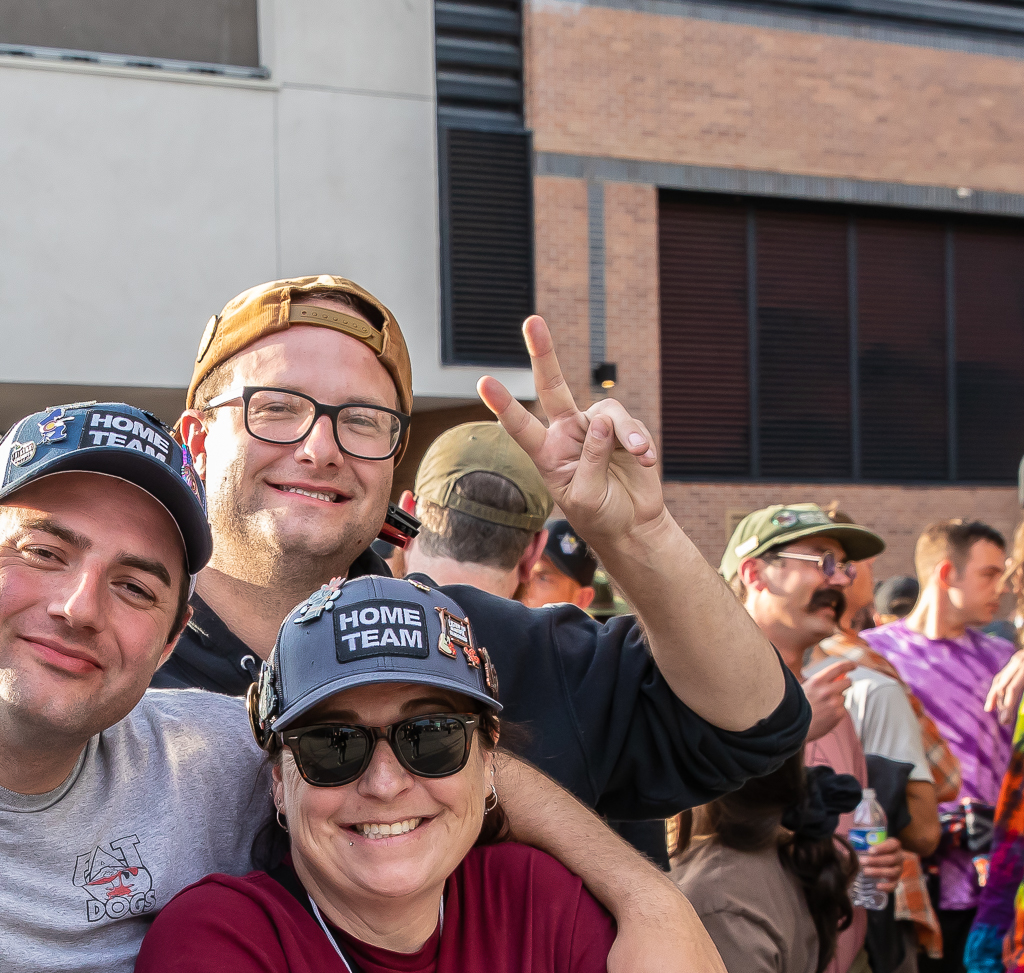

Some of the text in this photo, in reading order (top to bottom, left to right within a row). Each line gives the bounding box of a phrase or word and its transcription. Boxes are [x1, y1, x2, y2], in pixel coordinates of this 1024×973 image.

[88, 430, 167, 463] TEAM
[90, 413, 170, 455] HOME
[339, 606, 422, 631] HOME
[341, 628, 423, 652] TEAM
[72, 833, 140, 887] FAT
[86, 889, 157, 922] DOGS
